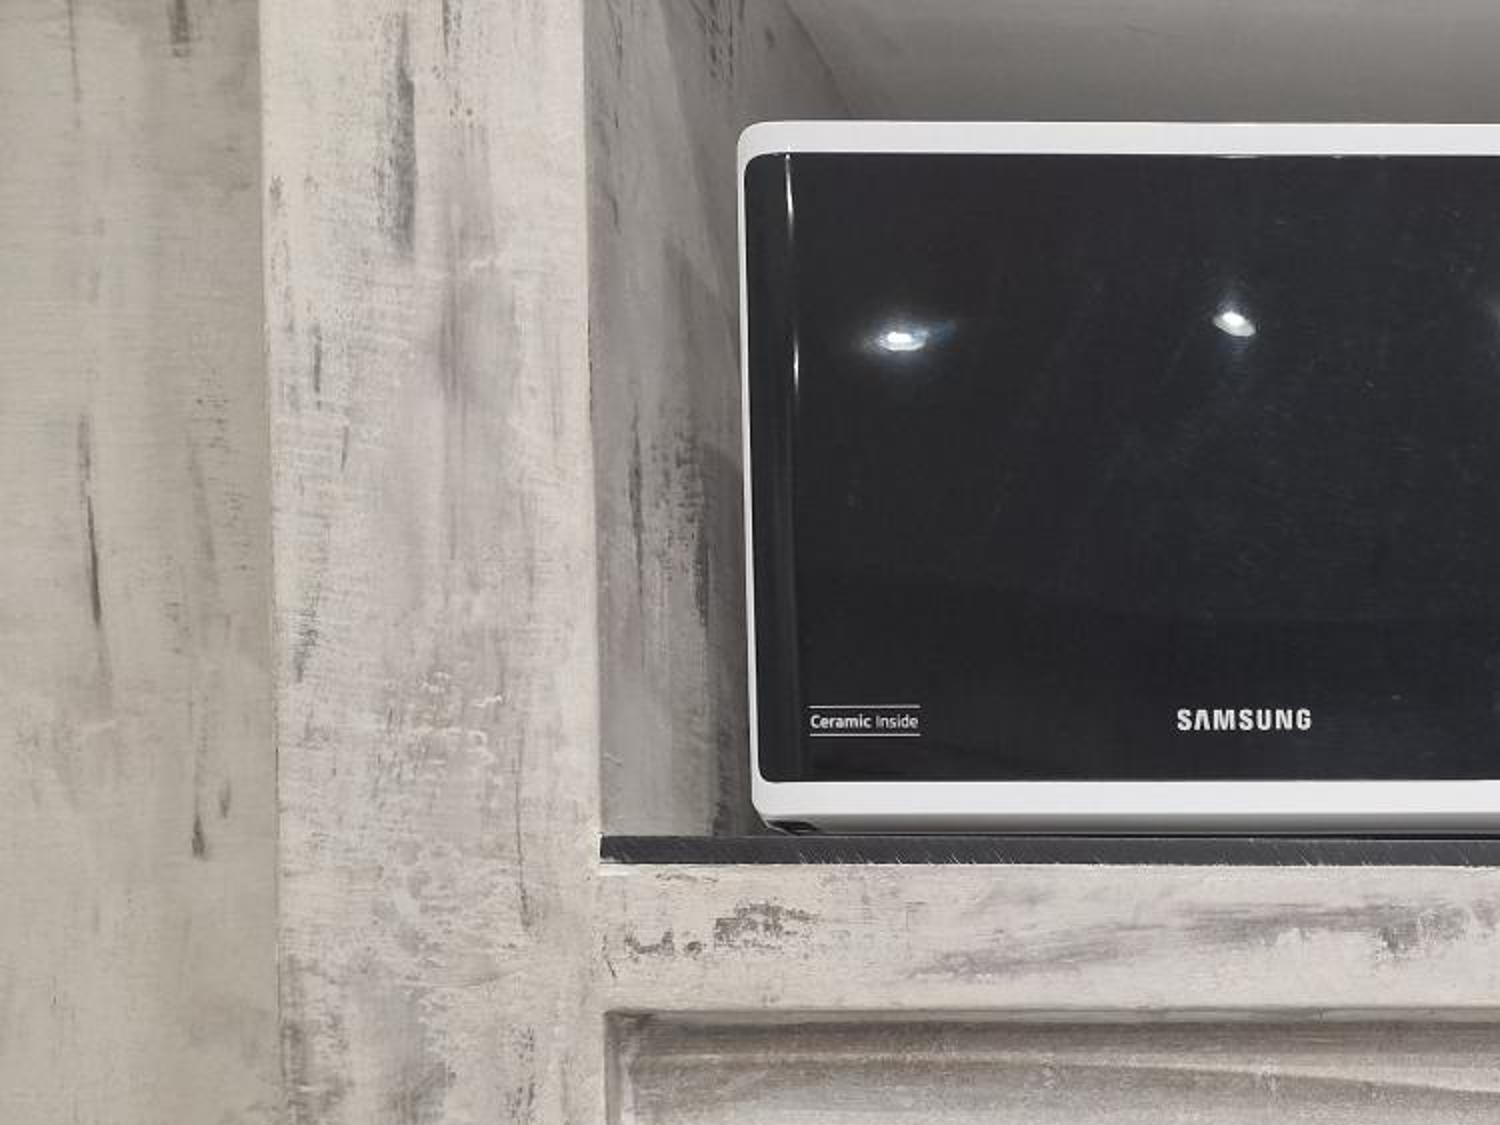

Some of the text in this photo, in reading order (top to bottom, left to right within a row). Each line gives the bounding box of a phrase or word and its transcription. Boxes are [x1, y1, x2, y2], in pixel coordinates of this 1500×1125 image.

[810, 713, 919, 729] Ceramic Inside
[1176, 708, 1312, 731] SAMSUNG
